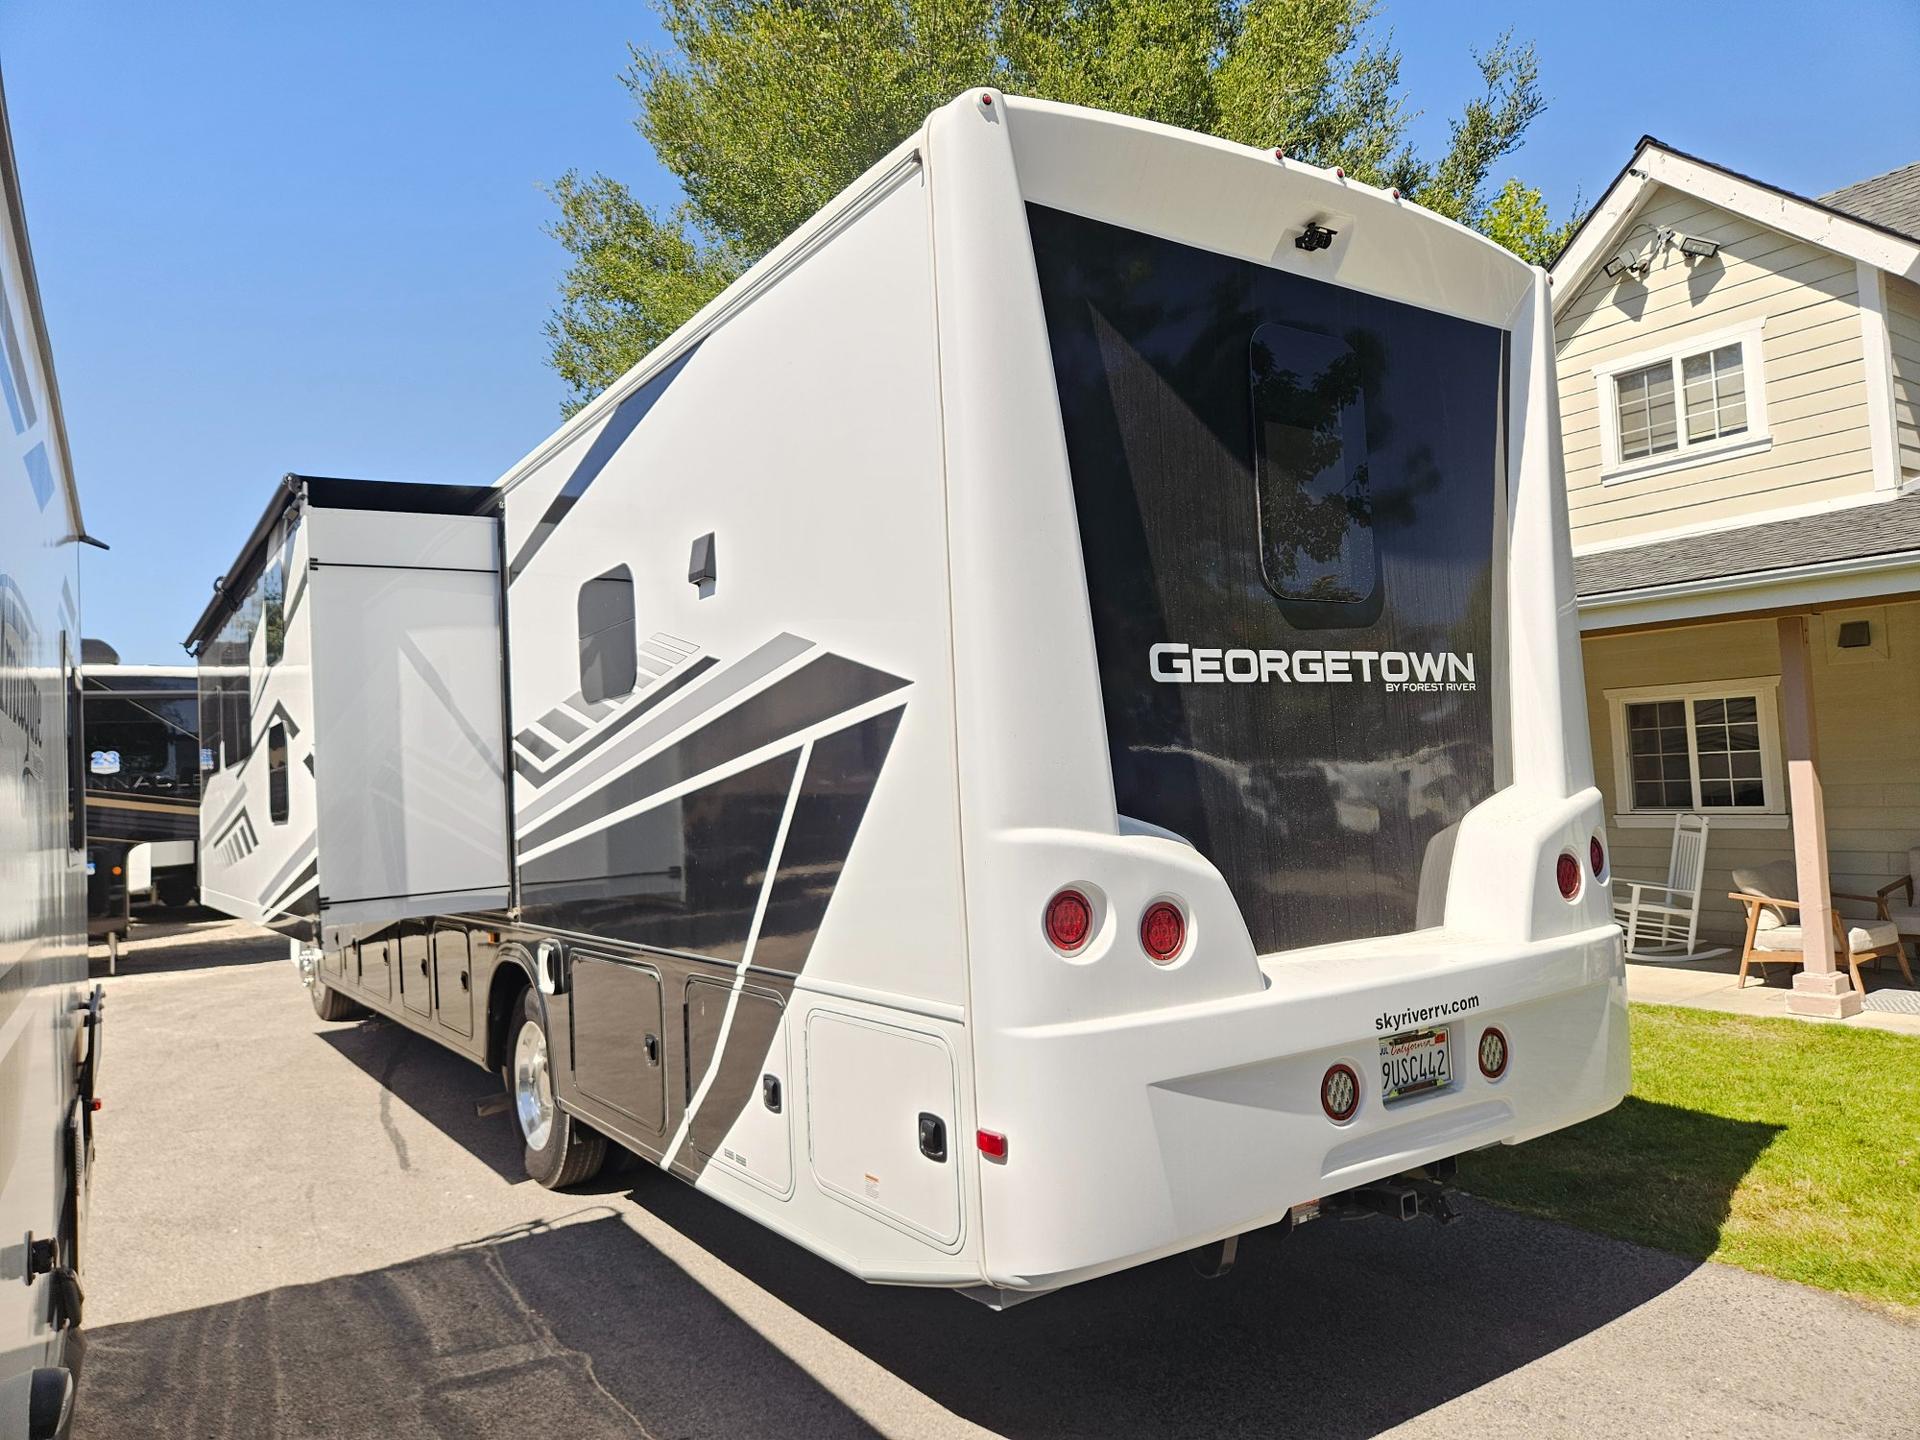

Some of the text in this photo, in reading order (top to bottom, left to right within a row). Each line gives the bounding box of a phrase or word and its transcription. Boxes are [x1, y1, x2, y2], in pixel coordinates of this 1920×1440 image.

[1149, 642, 1475, 683] GEORGETOWN
[1386, 682, 1476, 692] BY FOREST RIVER
[1375, 995, 1480, 1031] skyriverrv.com
[1390, 1039, 1433, 1056] California
[1382, 1050, 1446, 1090] 9USC442
